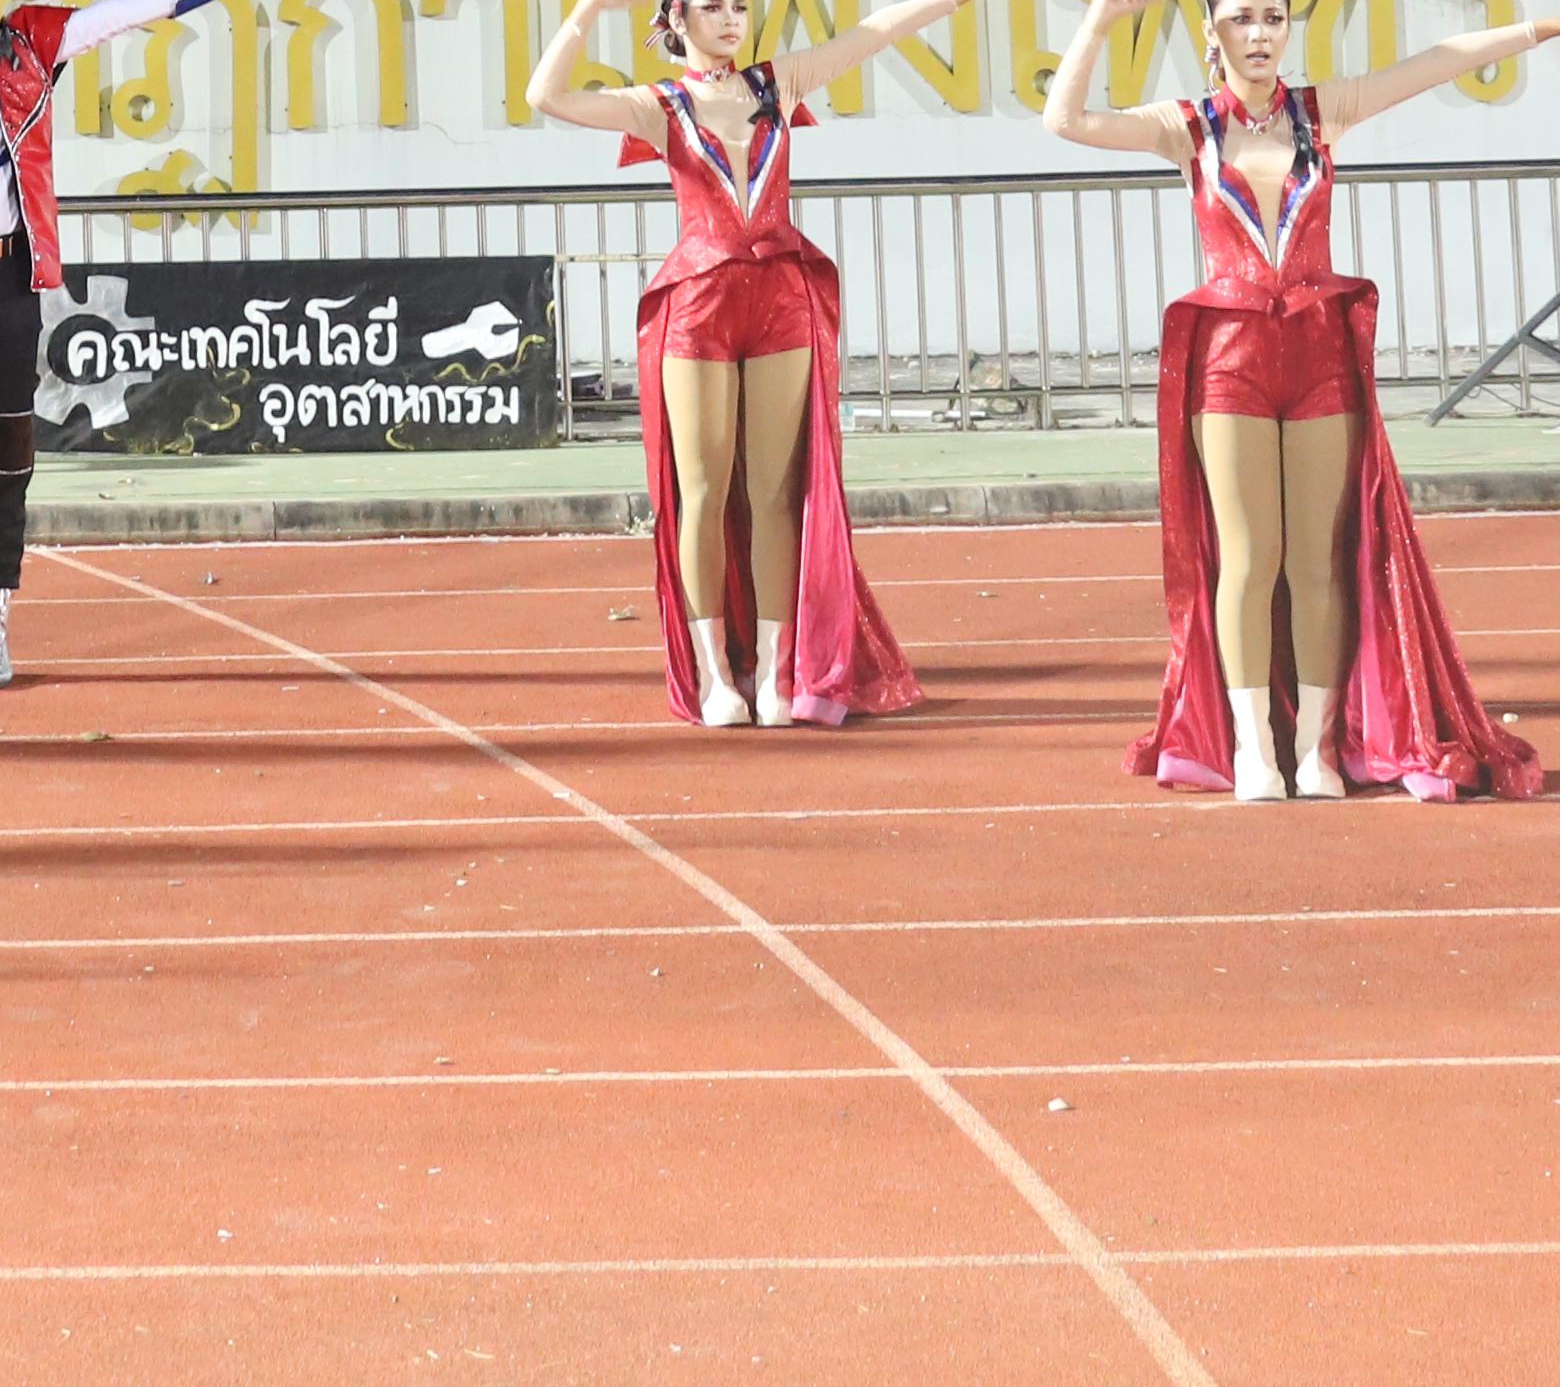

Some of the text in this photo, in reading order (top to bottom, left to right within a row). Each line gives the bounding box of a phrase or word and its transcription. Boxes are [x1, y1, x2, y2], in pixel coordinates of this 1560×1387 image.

[67, 295, 398, 378] คณะเทคโนโลยี
[258, 378, 520, 444] อุตสาหกรรม
